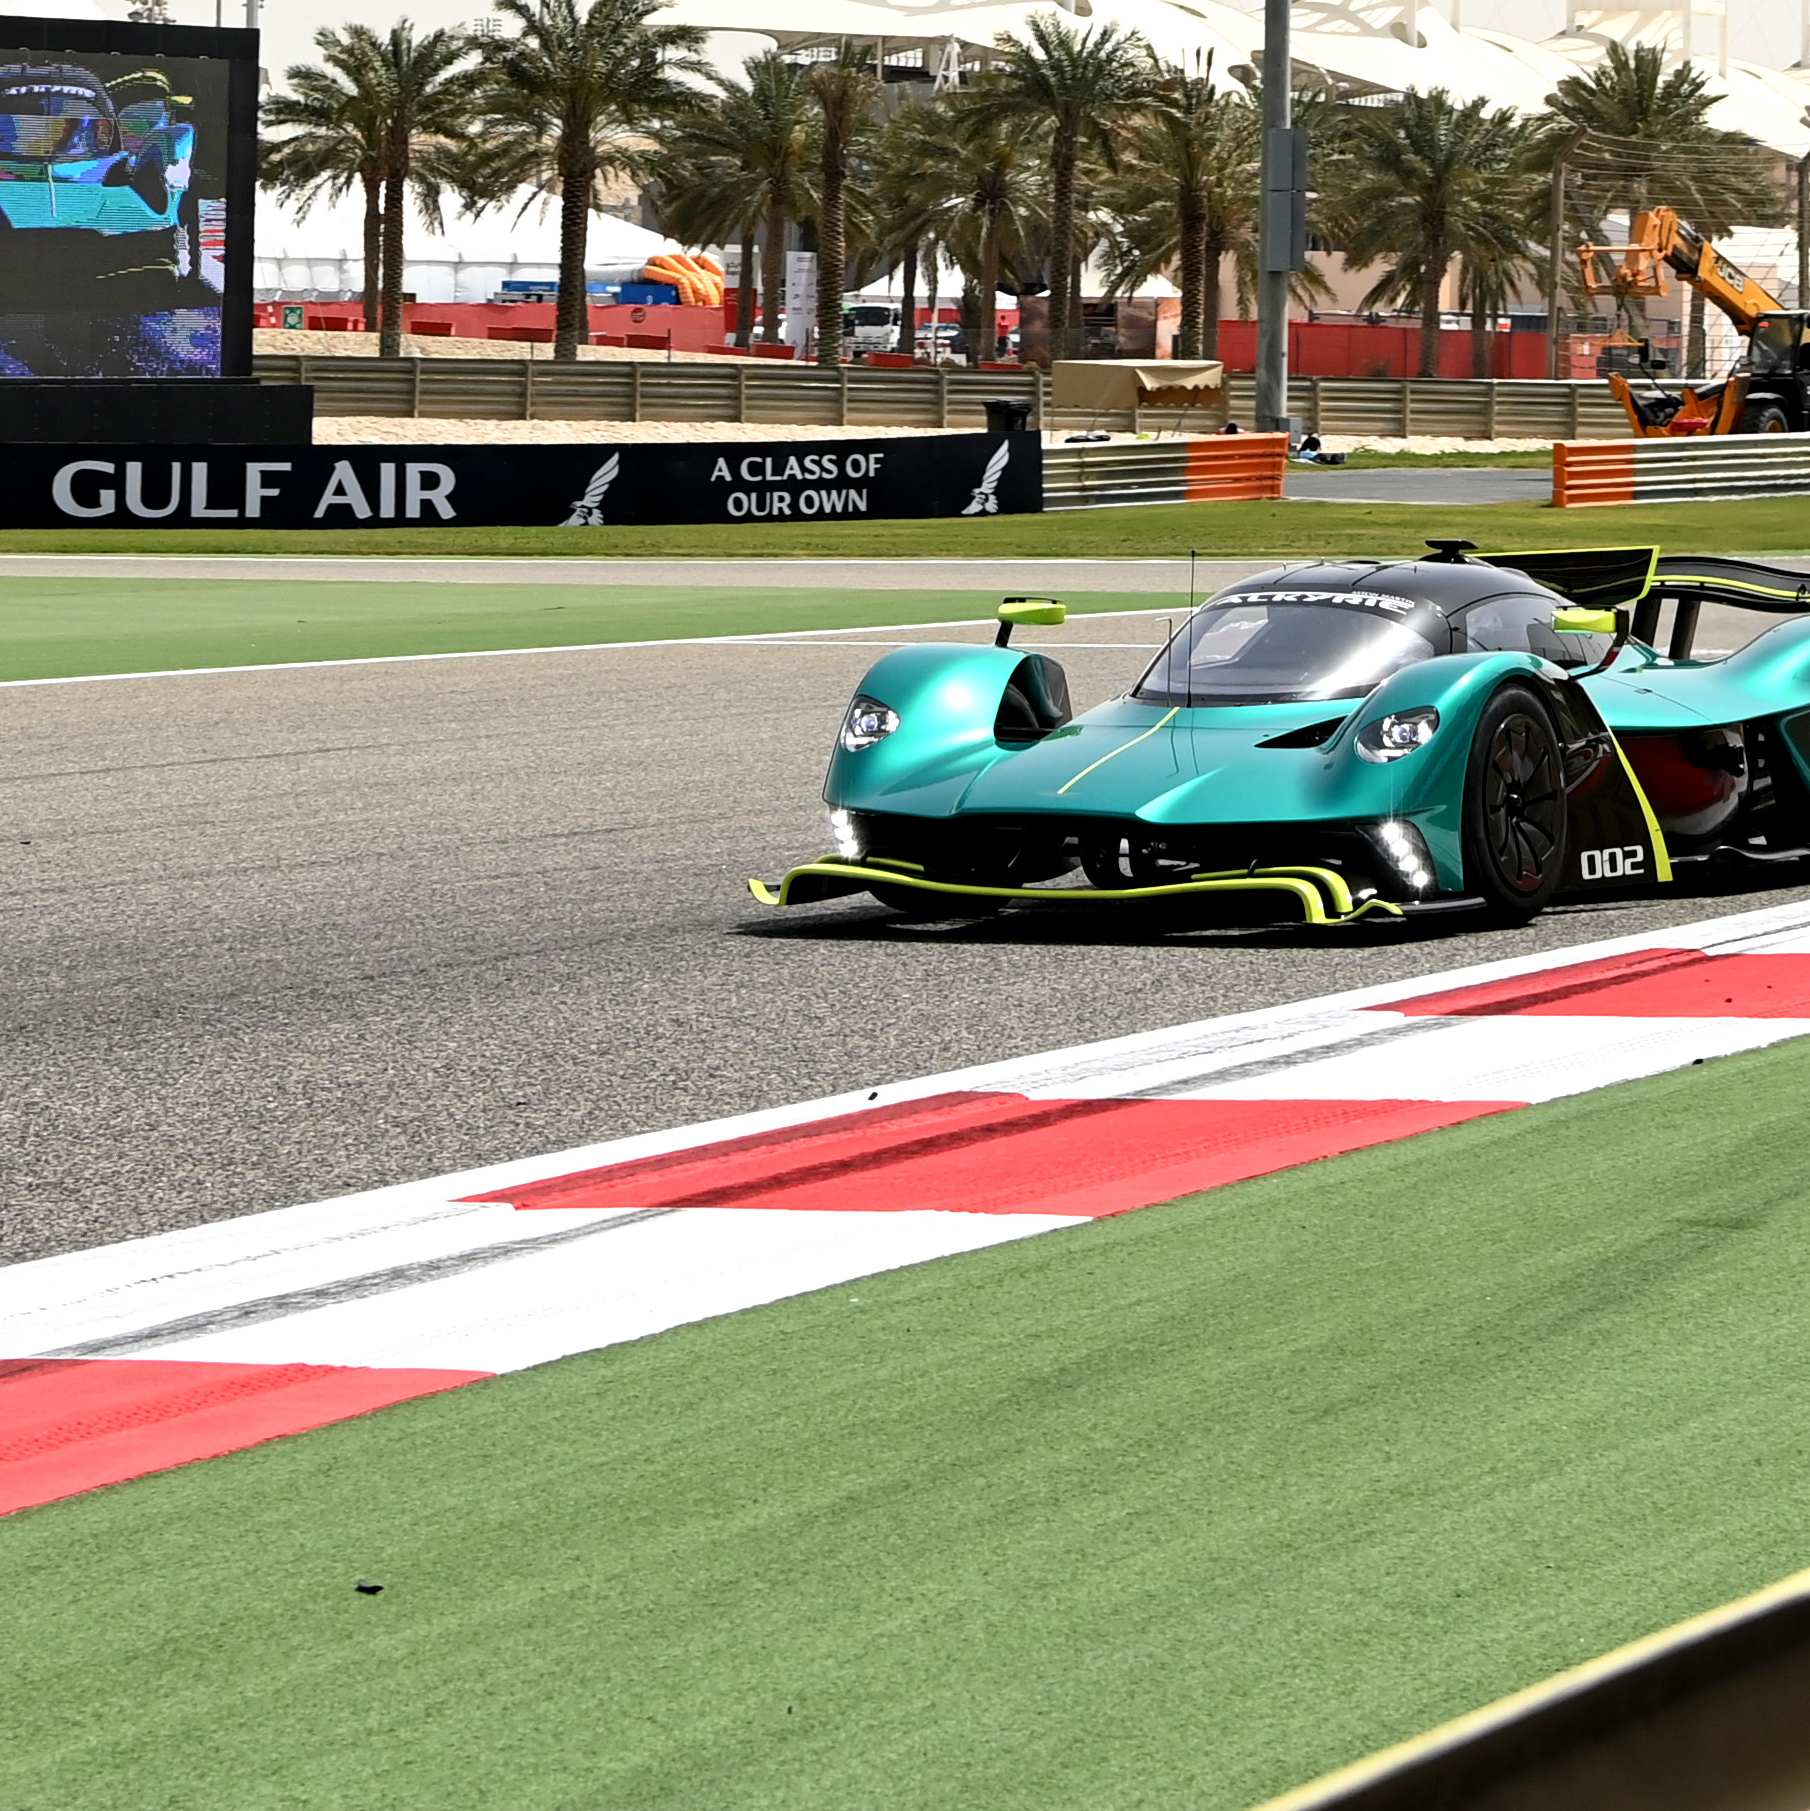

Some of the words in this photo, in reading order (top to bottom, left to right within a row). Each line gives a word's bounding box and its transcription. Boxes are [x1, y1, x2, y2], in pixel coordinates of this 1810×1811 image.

[711, 457, 732, 481] A
[741, 455, 837, 481] CLASS
[846, 453, 883, 477] OF
[53, 461, 291, 517] GULF
[314, 461, 457, 519] AIR
[727, 492, 791, 516] OUR
[800, 489, 867, 514] OWN
[1203, 592, 1409, 615] ALKYRIE
[1581, 845, 1645, 880] 002
